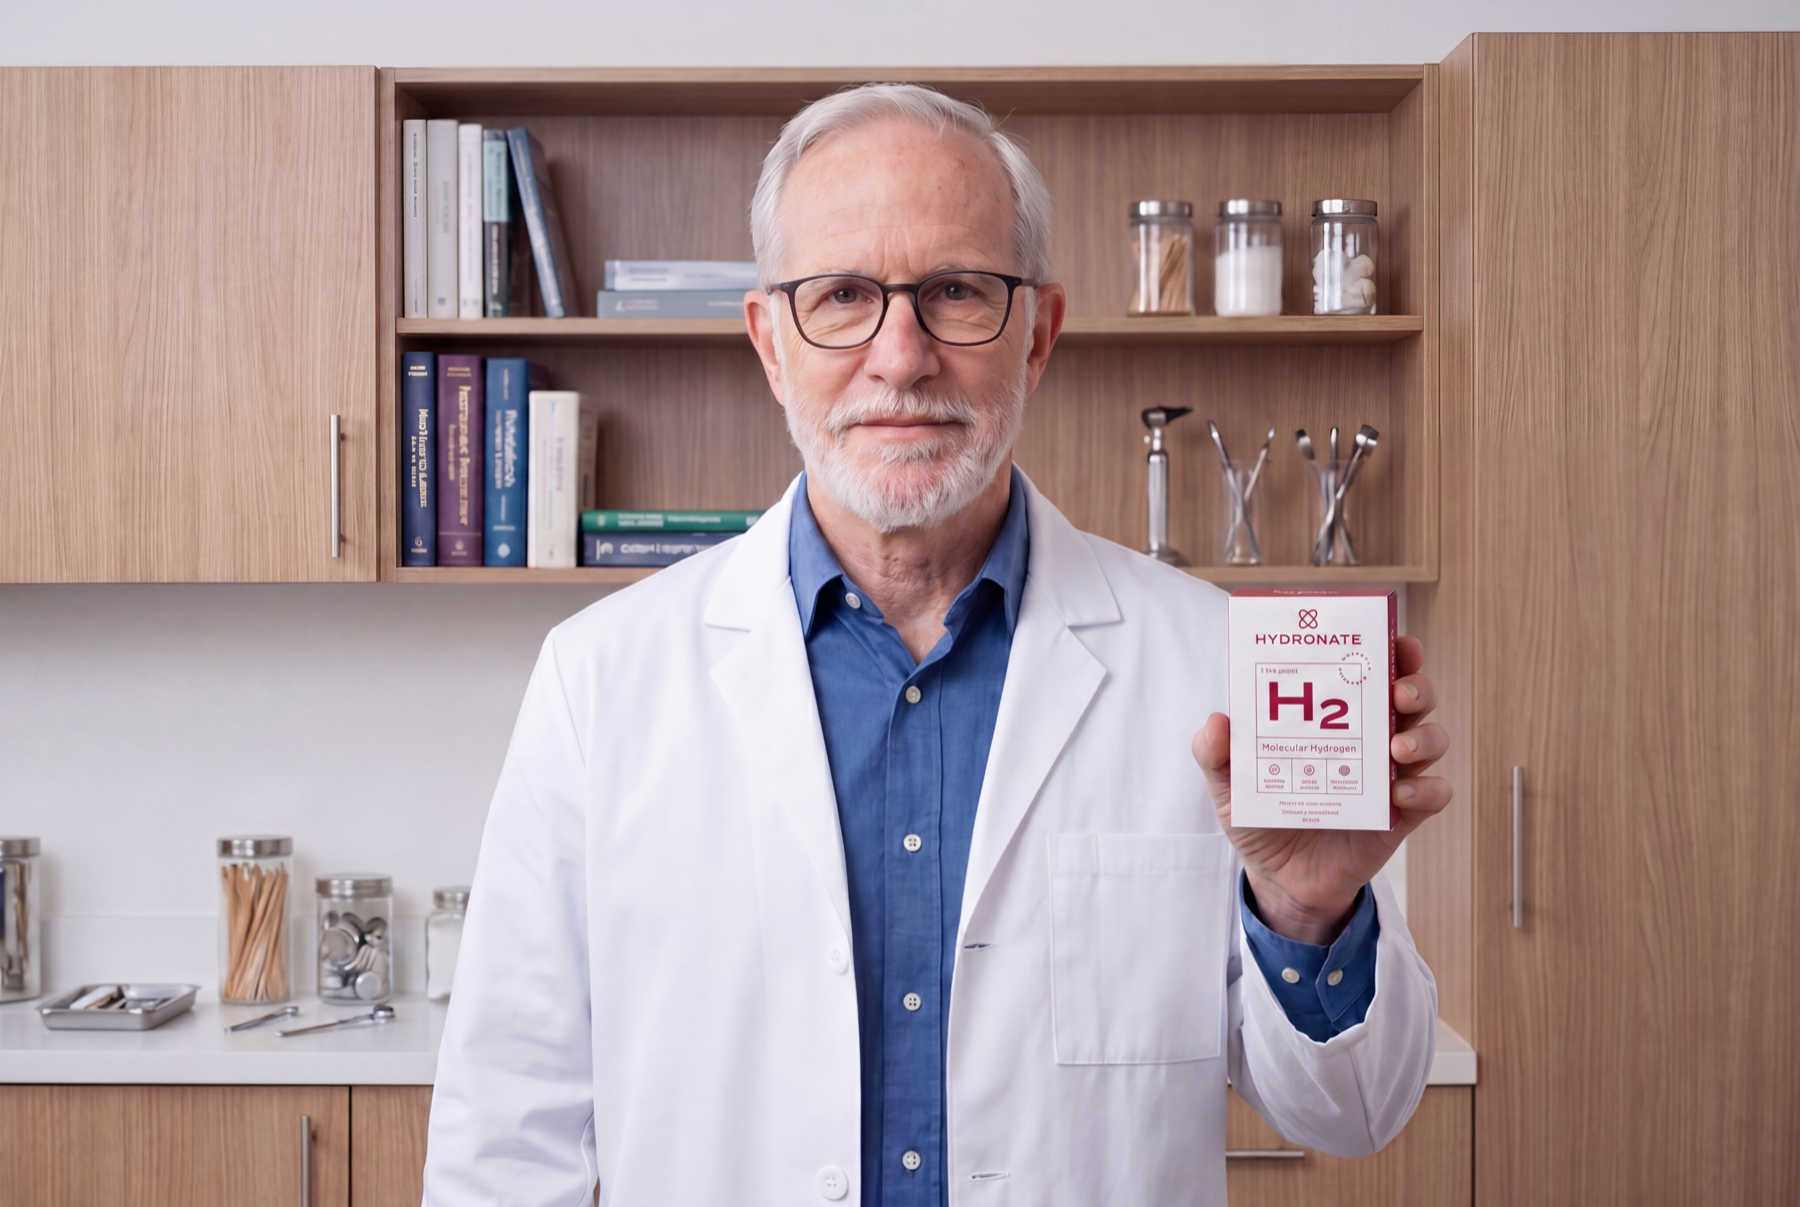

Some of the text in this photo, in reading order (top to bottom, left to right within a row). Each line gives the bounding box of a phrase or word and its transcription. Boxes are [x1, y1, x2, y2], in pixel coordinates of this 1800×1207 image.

[1255, 633, 1362, 646] HYDRONATE
[1268, 681, 1350, 730] H2
[1262, 743, 1357, 754] Molecular Hydrogen
